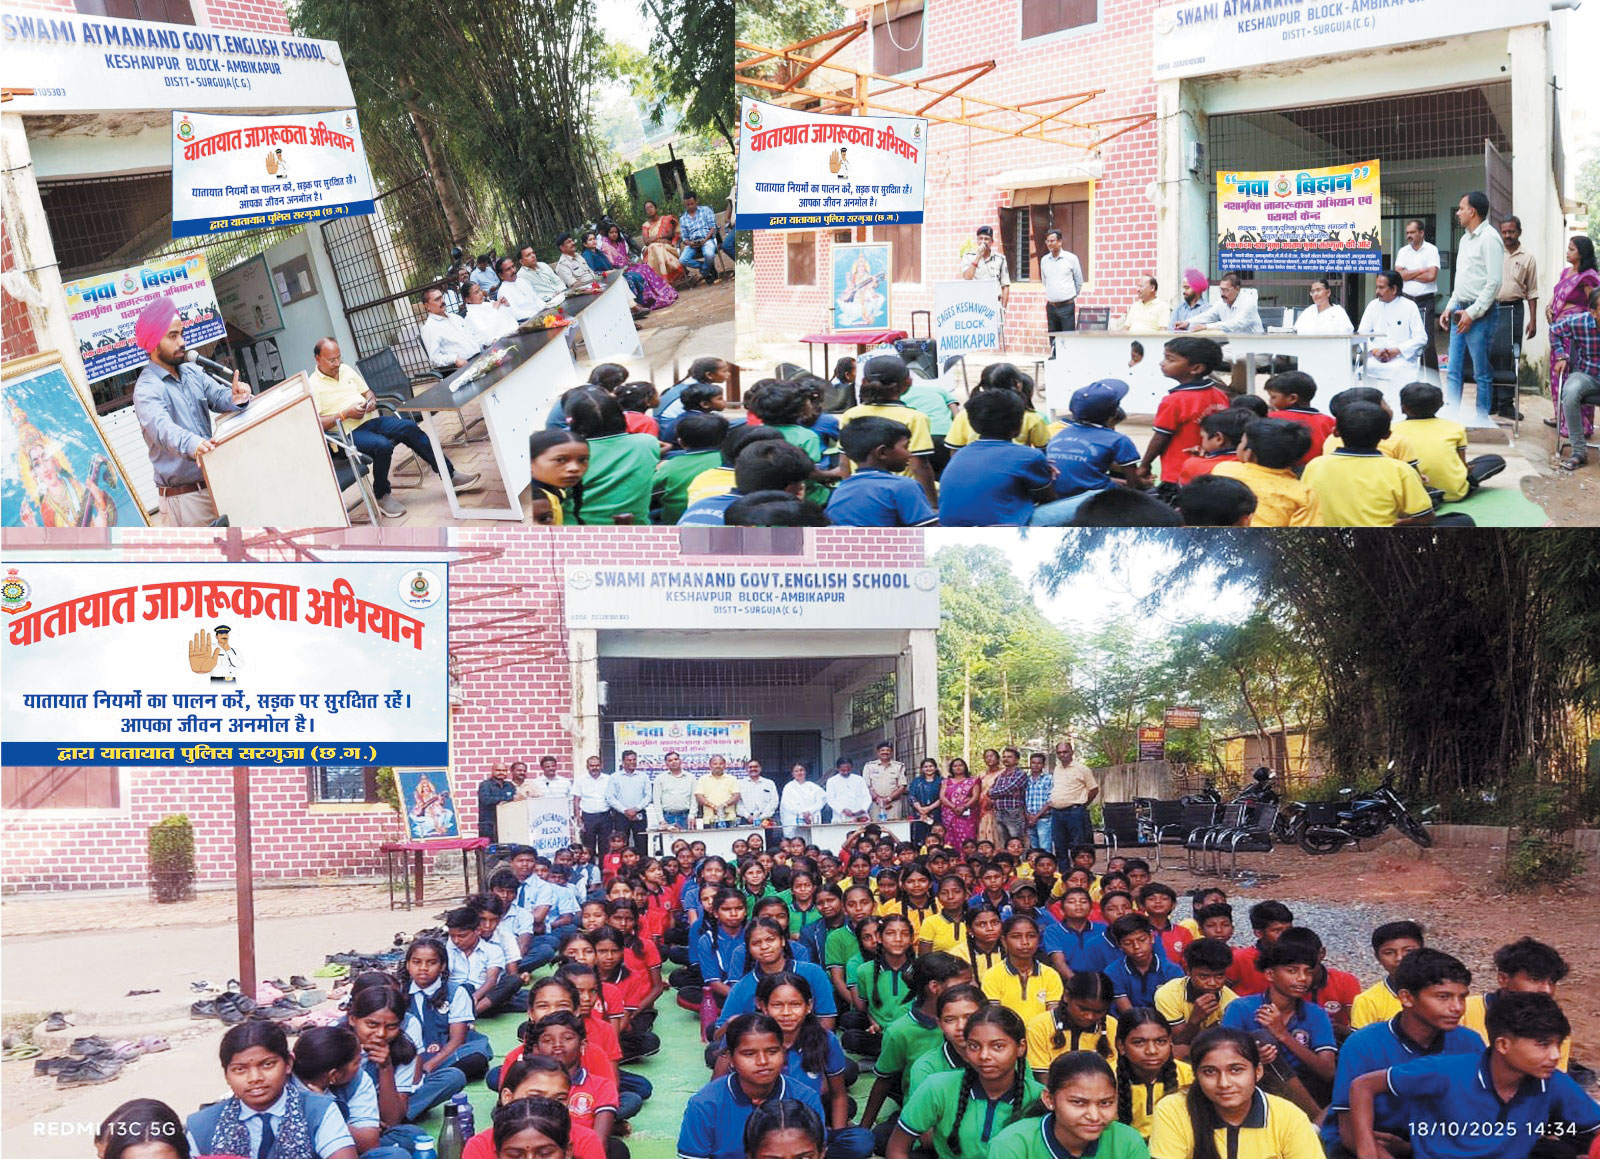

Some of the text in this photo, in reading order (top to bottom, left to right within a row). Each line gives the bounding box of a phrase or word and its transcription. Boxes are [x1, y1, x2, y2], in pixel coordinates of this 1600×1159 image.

[1176, 3, 1218, 27] SWAMI
[1238, 10, 1300, 33] KESHAVPUR
[1, 15, 77, 42] SWAMI
[82, 22, 180, 49] ATMANAND
[281, 41, 326, 60] SCHOOL
[105, 54, 181, 71] KESHAVPUR
[184, 121, 355, 161] यातायात जागरूकता अभियान
[751, 123, 918, 164] यातायात जागरूकता अभियान
[192, 187, 223, 197] यातायात
[225, 184, 248, 196] नियमों
[250, 186, 260, 194] का
[261, 184, 281, 193] पालन
[297, 181, 312, 192] सड़क
[313, 179, 322, 188] पर
[323, 176, 344, 190] सुरक्षित
[755, 182, 785, 192] यातायात
[787, 181, 809, 193] नियमों
[810, 184, 820, 193] का
[821, 184, 840, 193] पालन
[855, 185, 870, 195] सड़क
[871, 185, 880, 194] पर
[881, 183, 901, 197] सुरक्षित
[239, 199, 263, 209] आपका
[264, 196, 285, 206] जीवन
[286, 192, 312, 204] अनमोल
[798, 198, 821, 207] आपका
[823, 196, 842, 207] जीवन
[843, 196, 868, 207] अनमोल
[1316, 196, 1354, 208] अभियान
[1358, 192, 1372, 205] एवं
[209, 219, 228, 230] द्वारा
[230, 216, 265, 226] यातायात
[268, 212, 291, 224] पुलिस
[293, 209, 320, 220] सरगुजा
[769, 216, 787, 225] द्वारा
[789, 216, 821, 224] यातायात
[823, 213, 845, 225] पुलिस
[847, 215, 873, 225] सरगुजा
[936, 301, 996, 327] SAGES KESHAVPUR
[954, 319, 985, 330] BLOCK
[940, 332, 996, 350] AMBIKAPUR
[594, 571, 645, 588] SWAMI
[650, 571, 735, 588] ATMANAND
[852, 573, 910, 588] SCHOOL
[666, 591, 732, 602] KESHAVPUR
[8, 577, 425, 650] यातायात जागरूकता अभियान
[23, 694, 88, 709] यातायात
[93, 690, 142, 709] नियमों
[146, 694, 167, 709] का
[172, 694, 218, 709] पालन
[257, 694, 296, 712] सड़क
[299, 694, 320, 709] पर
[324, 690, 379, 714] सुरक्षित
[121, 718, 172, 733] आपका
[177, 714, 223, 733] जीवन
[228, 714, 291, 733] अनमोल
[56, 747, 96, 761] द्वारा
[100, 747, 175, 760] यातायात
[180, 744, 234, 764] पुलिस
[238, 747, 305, 764] सरगुजा
